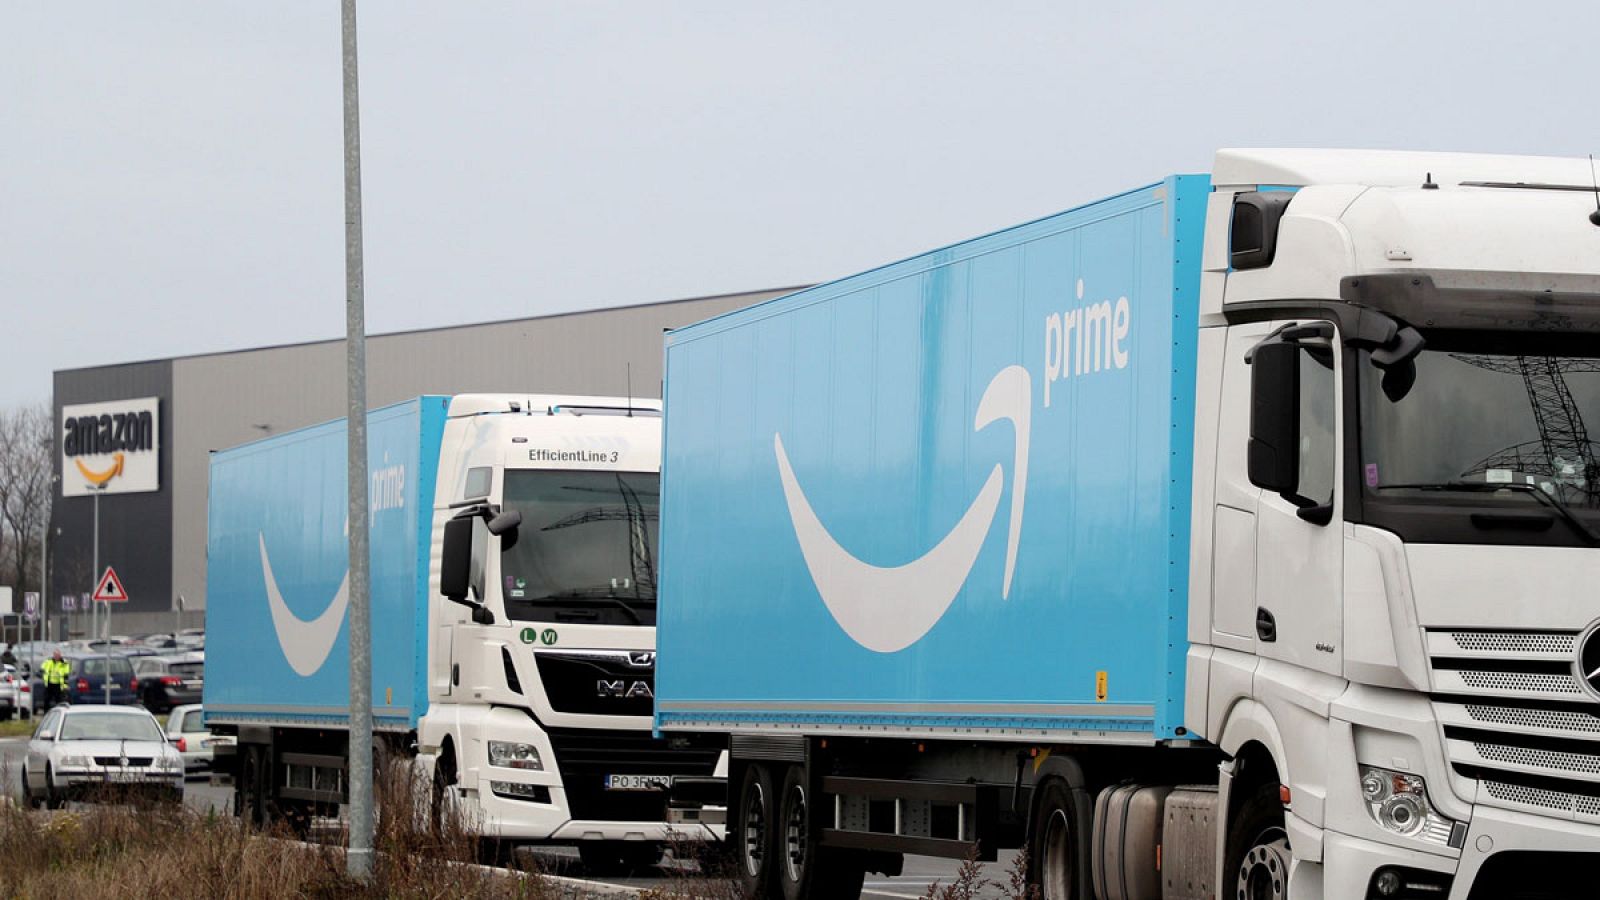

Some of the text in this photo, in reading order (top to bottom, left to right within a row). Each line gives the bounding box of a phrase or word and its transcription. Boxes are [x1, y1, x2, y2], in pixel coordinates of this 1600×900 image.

[1044, 278, 1130, 408] prime
[64, 410, 153, 457] amazon
[528, 449, 619, 463] EfficientLine 3
[371, 451, 405, 528] prime
[523, 630, 533, 643] L
[543, 631, 556, 644] VI
[597, 680, 654, 697] MA
